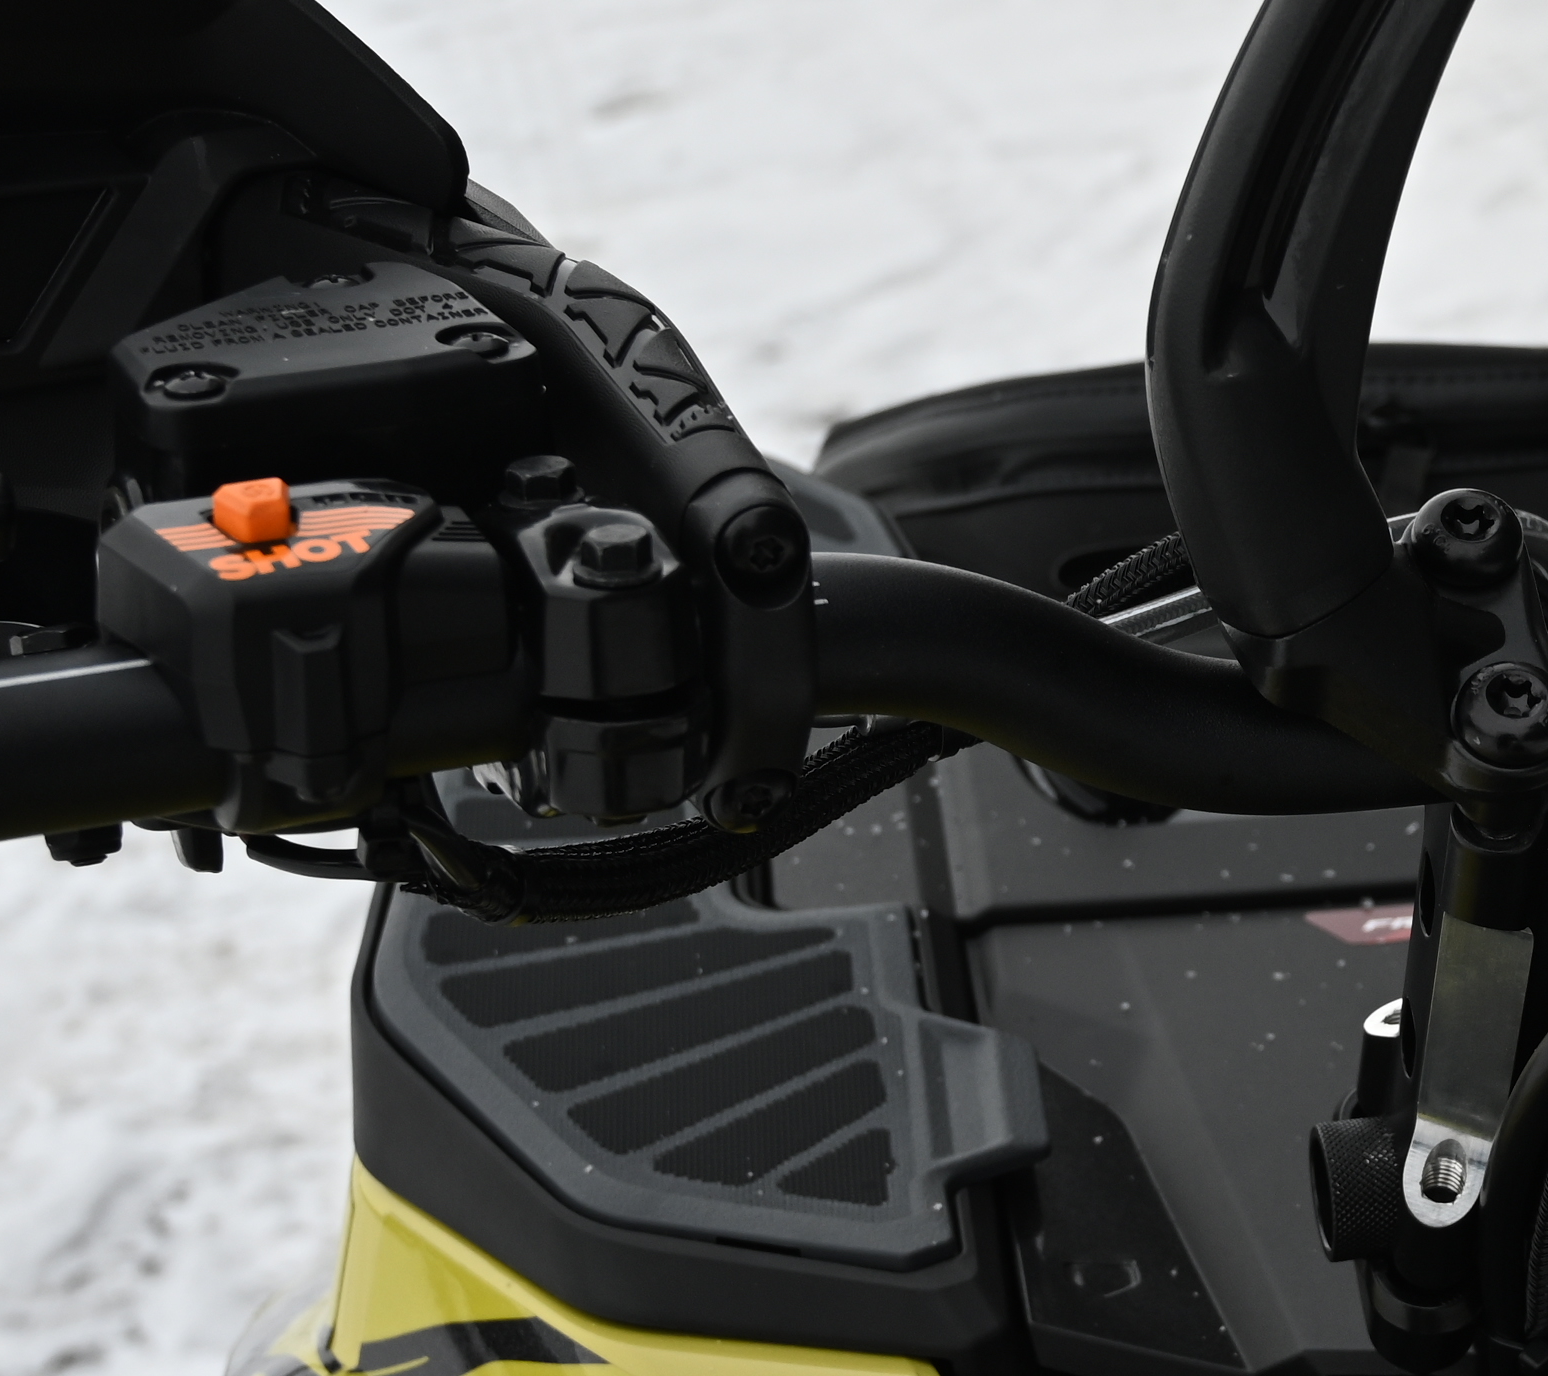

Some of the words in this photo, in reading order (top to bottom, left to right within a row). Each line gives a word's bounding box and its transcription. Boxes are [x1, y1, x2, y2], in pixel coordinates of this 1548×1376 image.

[140, 341, 204, 355] FLUID
[212, 334, 266, 347] FROM
[272, 332, 287, 340] A
[291, 323, 368, 337] SEALED
[374, 307, 489, 328] CONTAINER
[178, 318, 242, 333] CLEAN
[255, 308, 333, 323] FILLER
[344, 302, 381, 314] CAP
[393, 291, 469, 308] BEFORE
[276, 318, 317, 330] USE
[328, 311, 376, 324] ONLY
[390, 305, 427, 317] DOT
[442, 303, 454, 311] 4
[208, 529, 373, 581] SHOT
